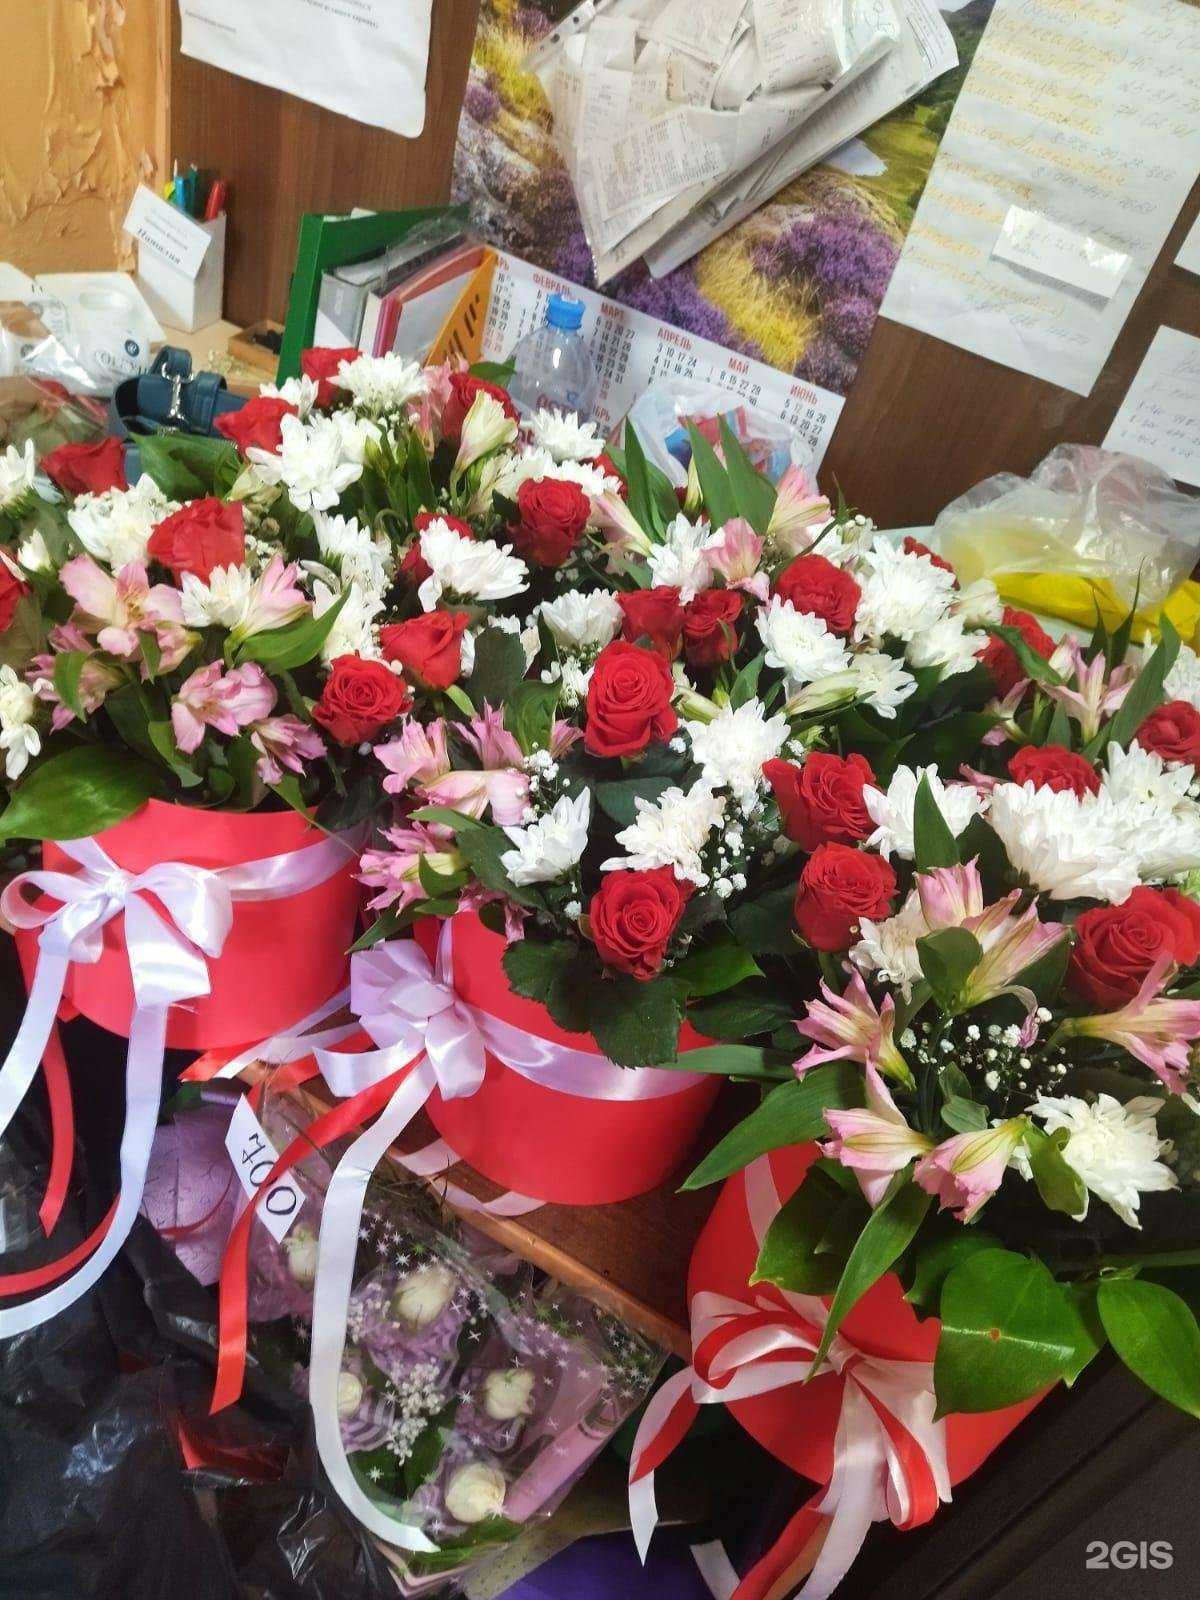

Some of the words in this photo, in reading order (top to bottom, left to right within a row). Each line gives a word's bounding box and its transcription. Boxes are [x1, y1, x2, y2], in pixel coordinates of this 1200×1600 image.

[601, 302, 624, 320] МАРТ
[657, 327, 692, 351] АПРЕЛЬ
[728, 357, 750, 375] МАЙ
[790, 384, 818, 405] ИЮНЬ
